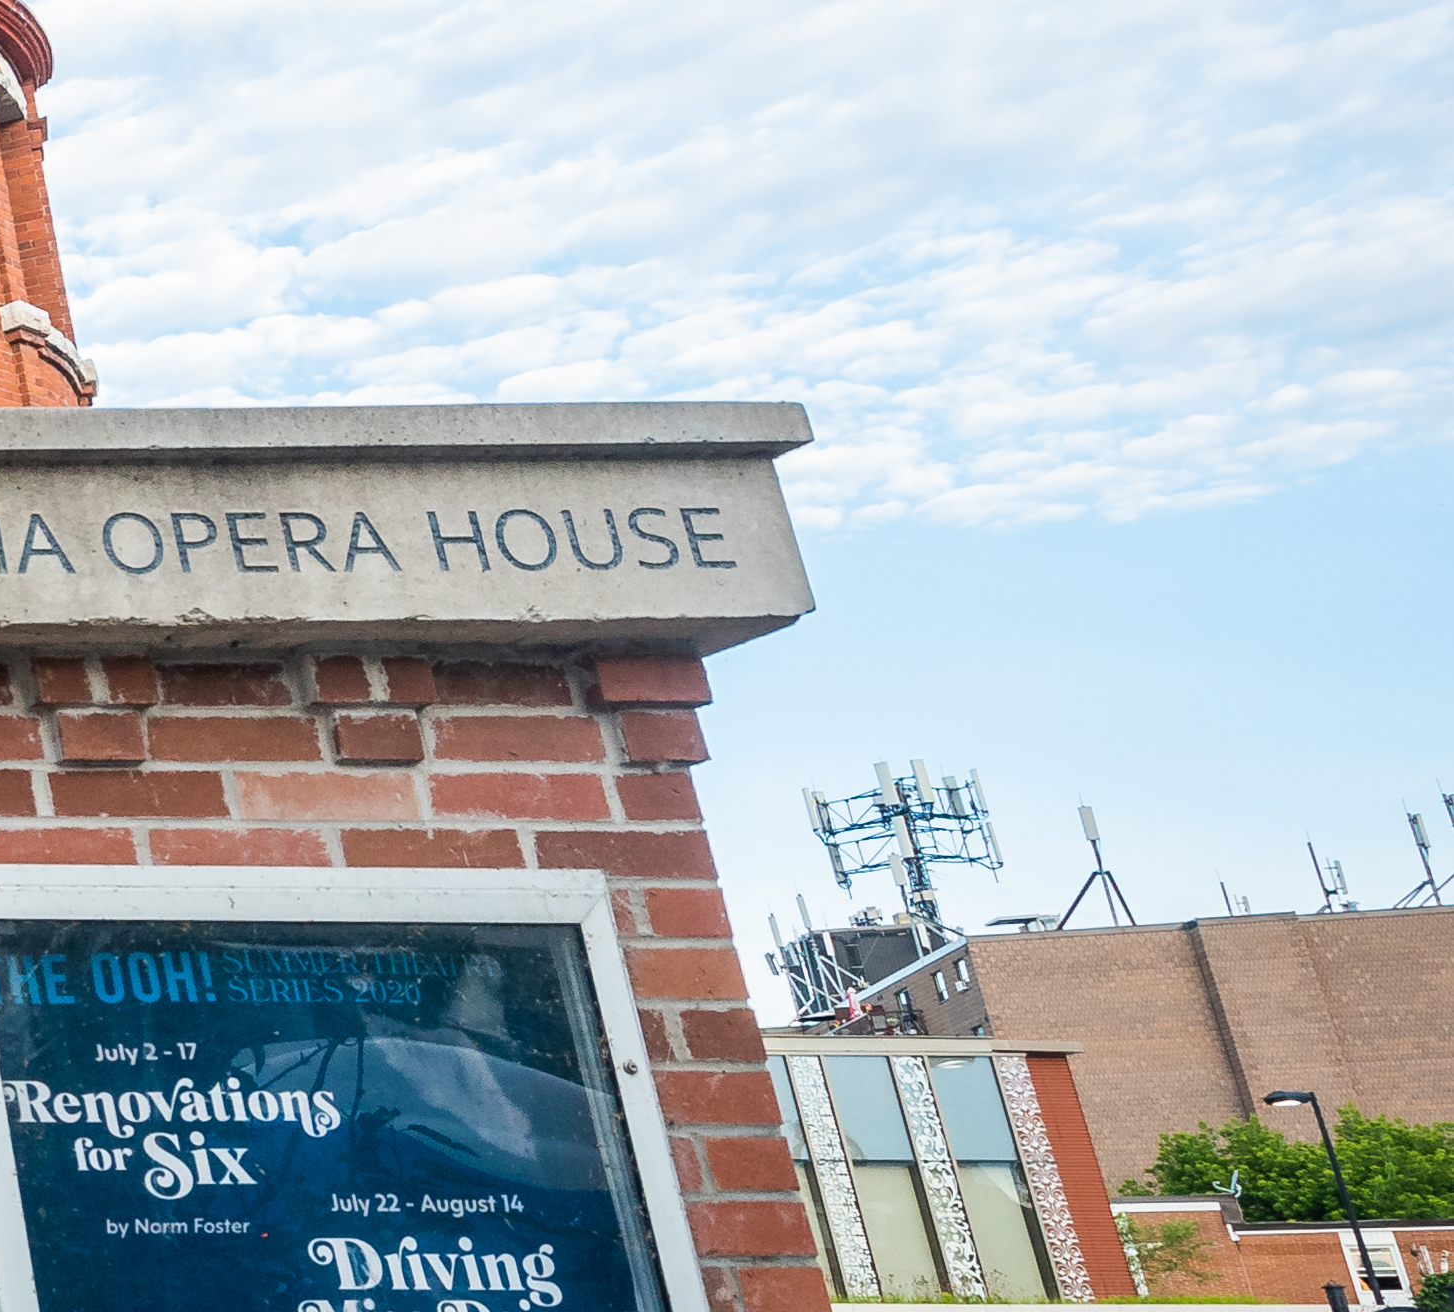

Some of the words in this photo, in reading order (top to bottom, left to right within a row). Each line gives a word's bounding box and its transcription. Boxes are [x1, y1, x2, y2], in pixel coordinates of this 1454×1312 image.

[101, 509, 401, 576] OPERA
[422, 505, 737, 572] HOUSE
[90, 951, 216, 1004] OOH!
[228, 978, 344, 1003] SERIES
[354, 980, 421, 1004] 2020
[2, 1077, 342, 1138] Renovations
[73, 1137, 133, 1173] for
[144, 1130, 258, 1201] Six
[330, 1192, 371, 1217] July
[375, 1193, 399, 1213] 22
[419, 1192, 495, 1217] August
[500, 1193, 524, 1213] 14
[307, 1237, 557, 1308] Driving
